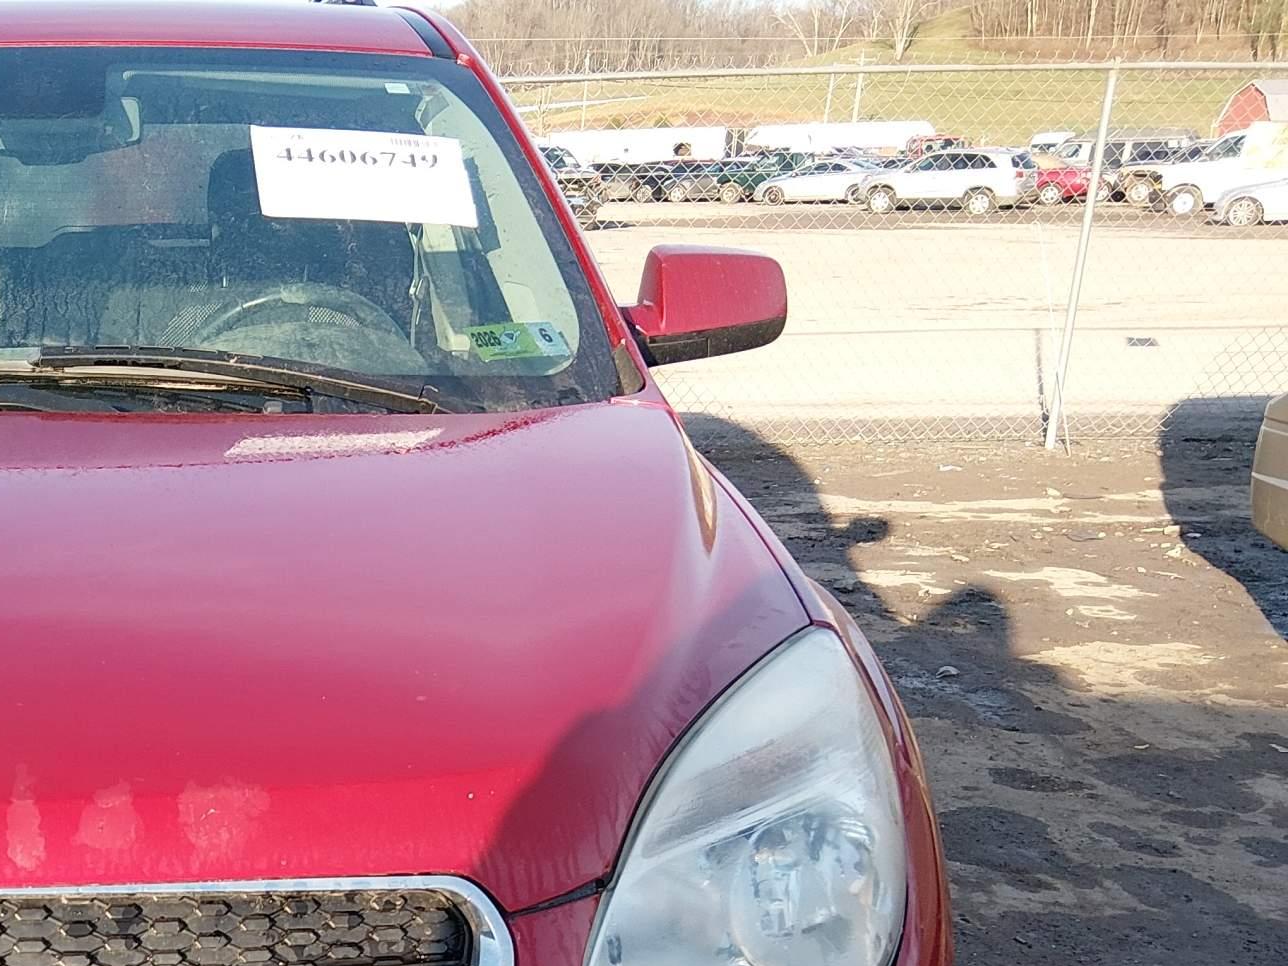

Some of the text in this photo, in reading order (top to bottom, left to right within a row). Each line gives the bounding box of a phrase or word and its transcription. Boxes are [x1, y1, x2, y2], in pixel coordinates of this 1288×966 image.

[276, 146, 439, 169] 44606749
[470, 330, 502, 348] 2026
[538, 327, 553, 343] 6
